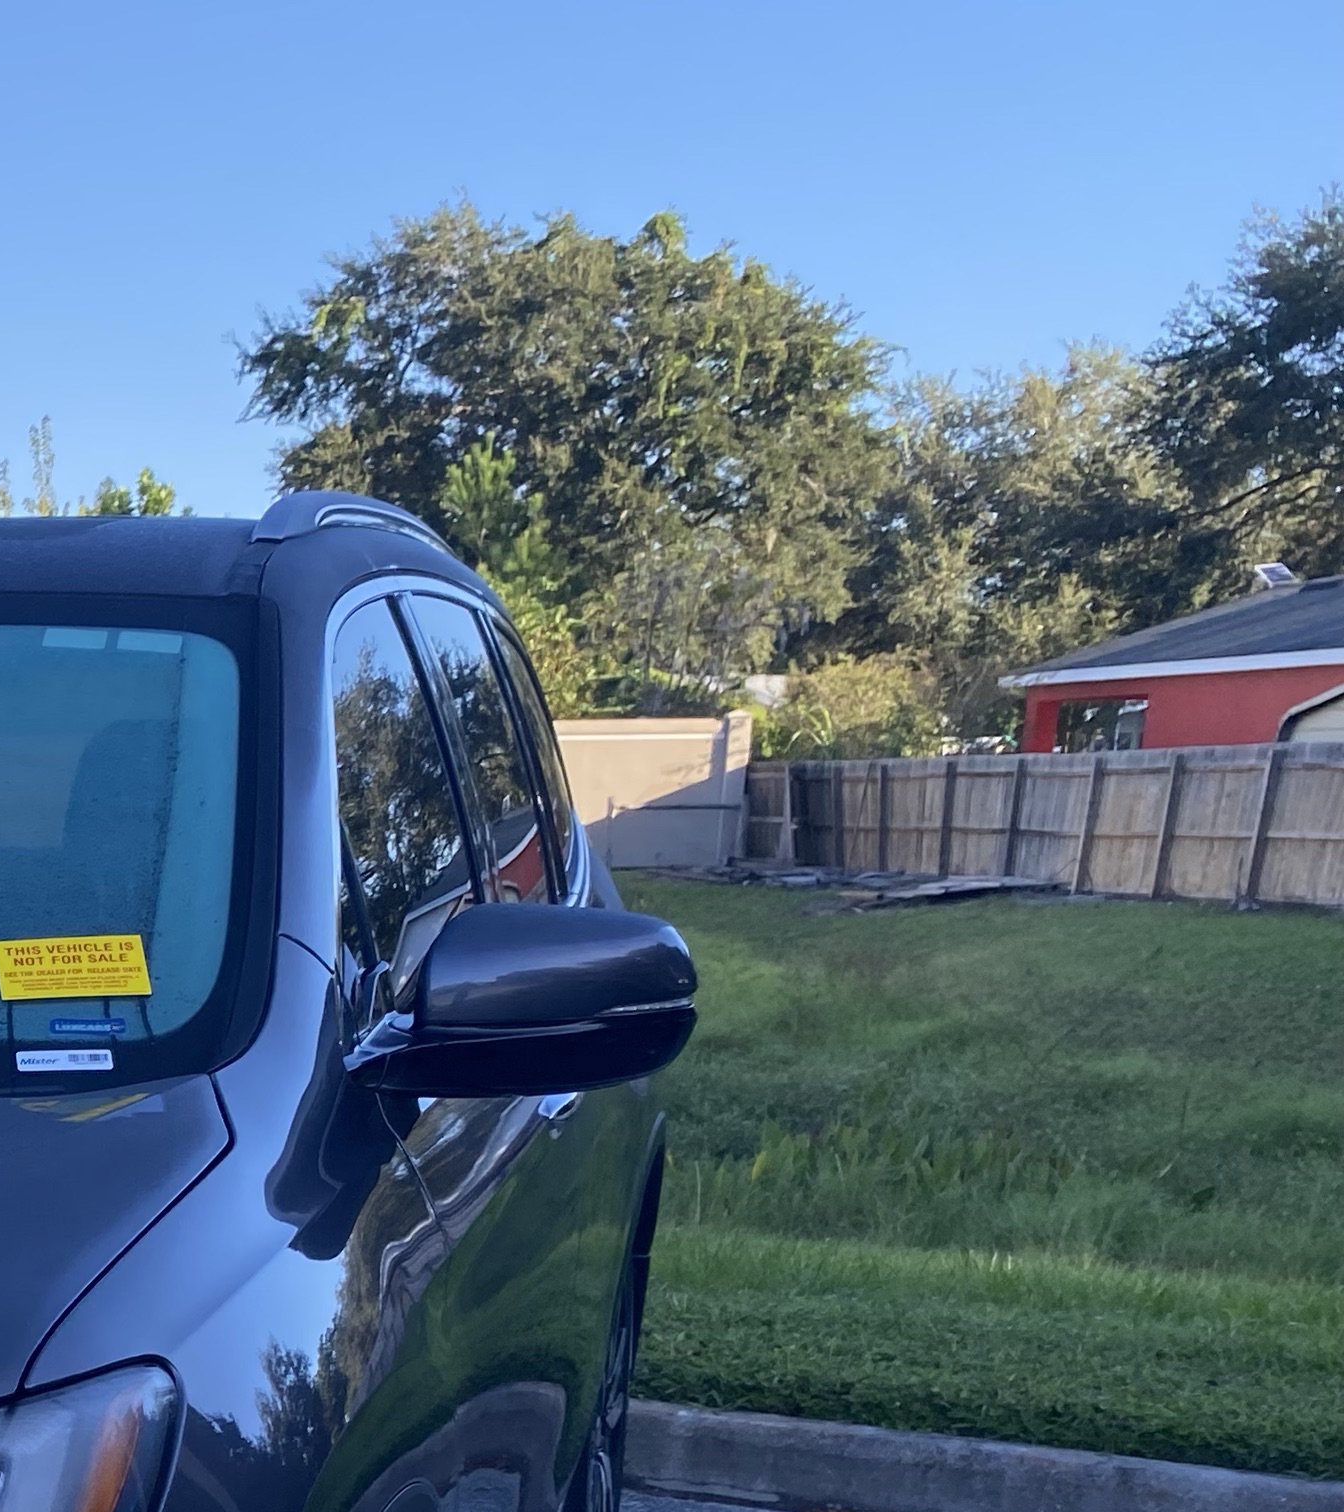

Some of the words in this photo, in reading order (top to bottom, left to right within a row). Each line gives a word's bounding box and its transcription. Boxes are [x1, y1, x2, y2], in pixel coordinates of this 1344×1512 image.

[3, 945, 41, 957] THIS
[45, 942, 114, 954] VEHICLE
[119, 941, 135, 951] IS
[13, 956, 45, 967] NOT
[51, 954, 83, 965] FOR
[87, 953, 129, 963] SALE
[36, 968, 66, 977] DEALER
